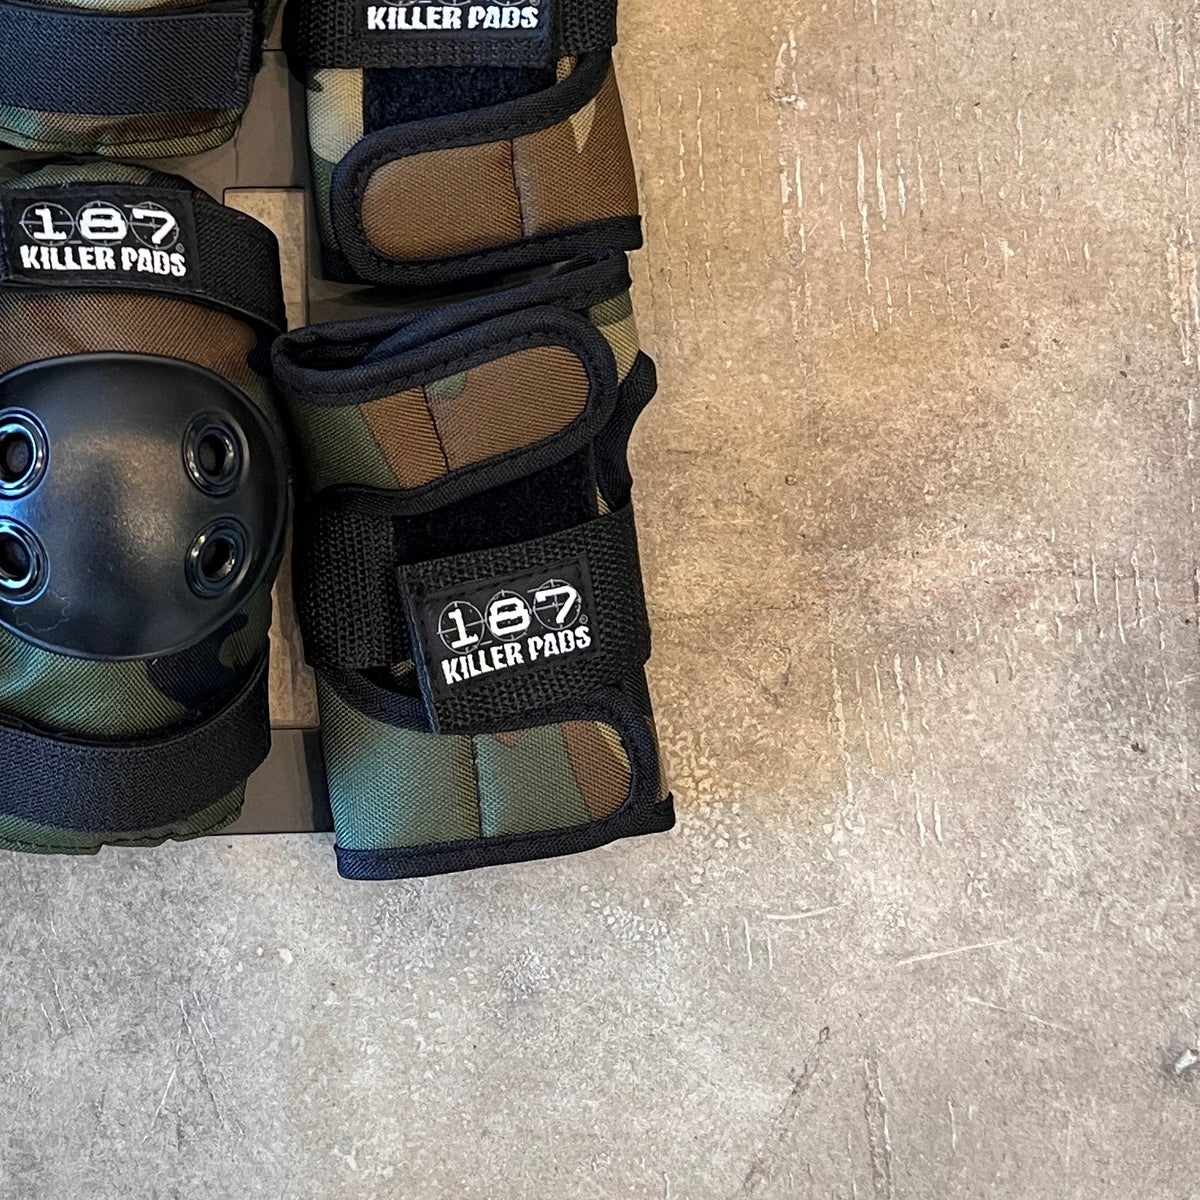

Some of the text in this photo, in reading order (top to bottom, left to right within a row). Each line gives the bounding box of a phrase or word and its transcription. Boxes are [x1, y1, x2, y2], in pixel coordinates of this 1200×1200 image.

[367, 5, 539, 30] KILLER PADS
[33, 207, 176, 244] 187
[19, 245, 187, 277] KILLER PADS
[448, 585, 577, 649] 187
[441, 625, 591, 685] KILLER PADS
